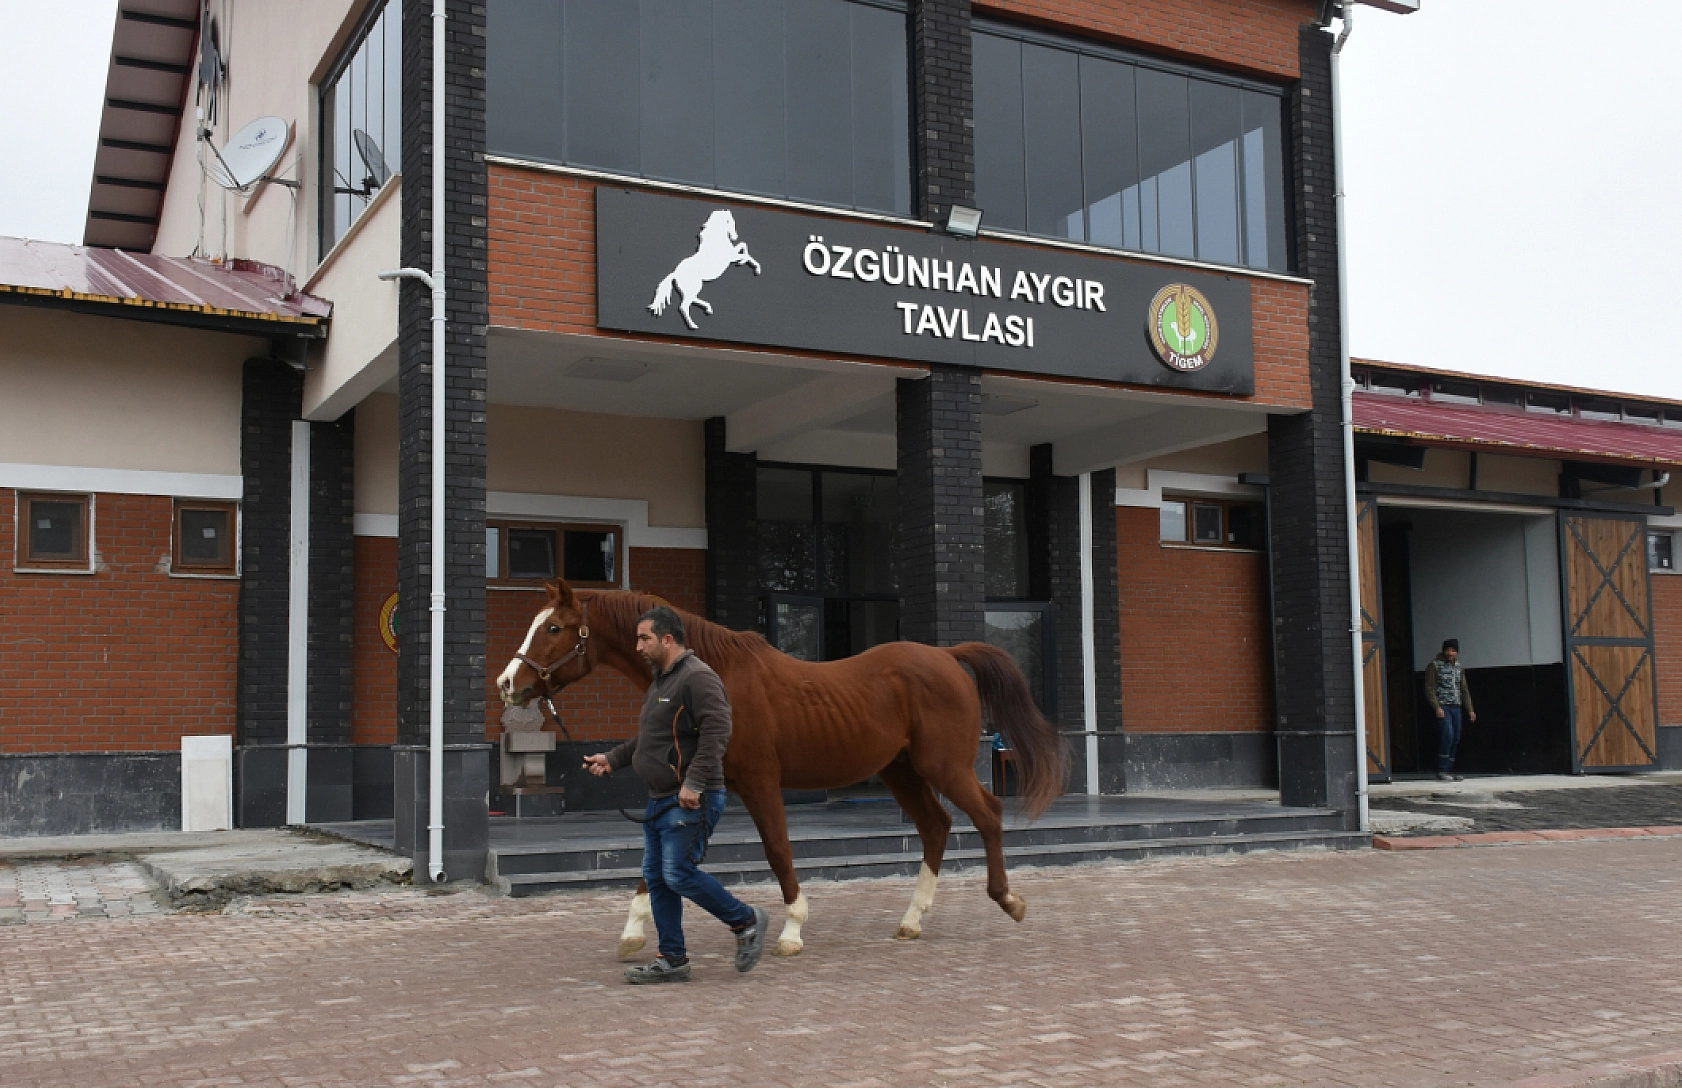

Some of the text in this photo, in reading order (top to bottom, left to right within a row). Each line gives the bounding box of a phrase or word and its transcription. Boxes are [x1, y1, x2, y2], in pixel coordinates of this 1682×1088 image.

[803, 235, 1107, 312] ÖZGÜNHAN AYGIR
[896, 301, 1035, 348] TAVLASI
